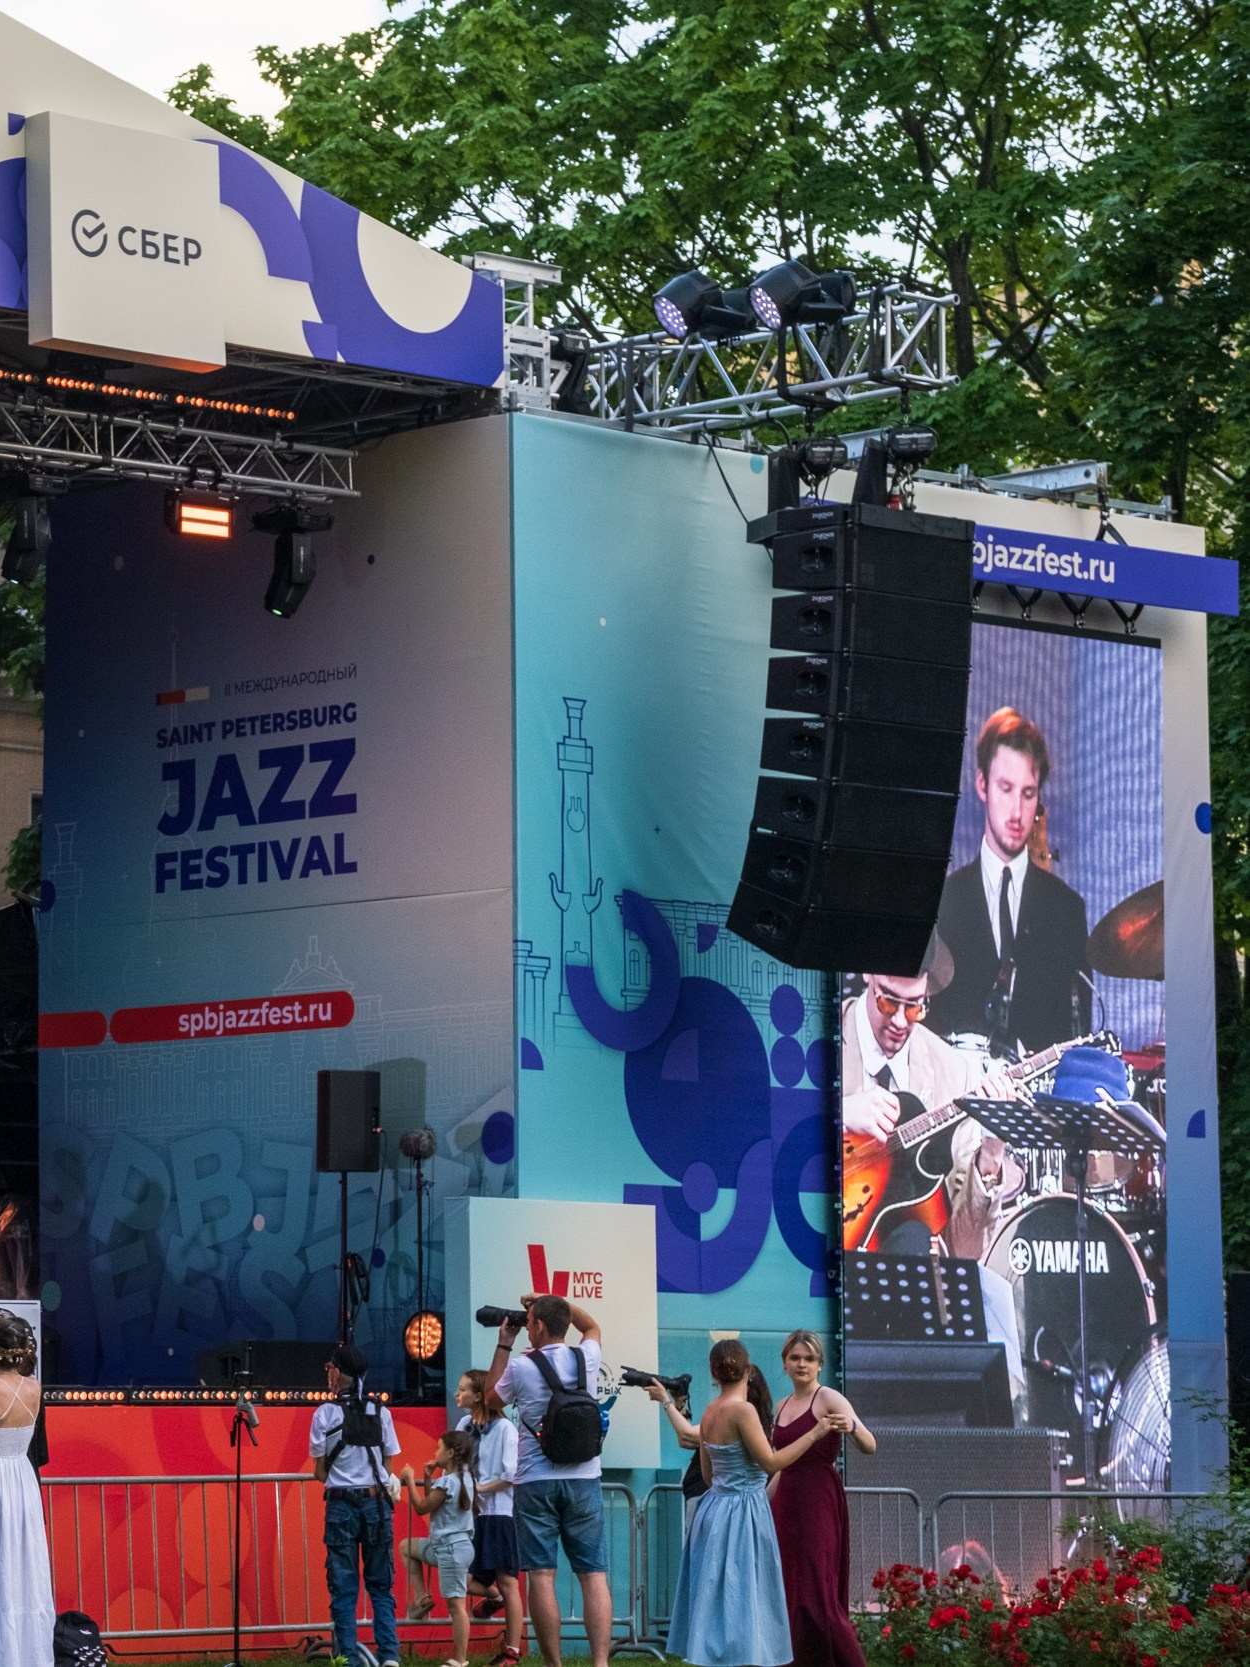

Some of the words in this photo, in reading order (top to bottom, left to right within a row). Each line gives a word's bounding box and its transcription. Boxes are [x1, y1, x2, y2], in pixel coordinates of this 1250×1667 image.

[118, 225, 203, 267] СБЕР
[234, 662, 357, 695] МЕЖДУНАРОДНЫЙ
[156, 721, 216, 749] SAINT
[222, 702, 357, 740] PETERSBURG
[156, 737, 358, 837] JAZZ
[155, 832, 358, 894] FESTIVAL
[178, 1001, 333, 1037] spbjazzfest.ru
[1031, 1240, 1110, 1273] YAMAHA
[573, 1271, 603, 1285] МТС
[573, 1286, 603, 1299] LIVE
